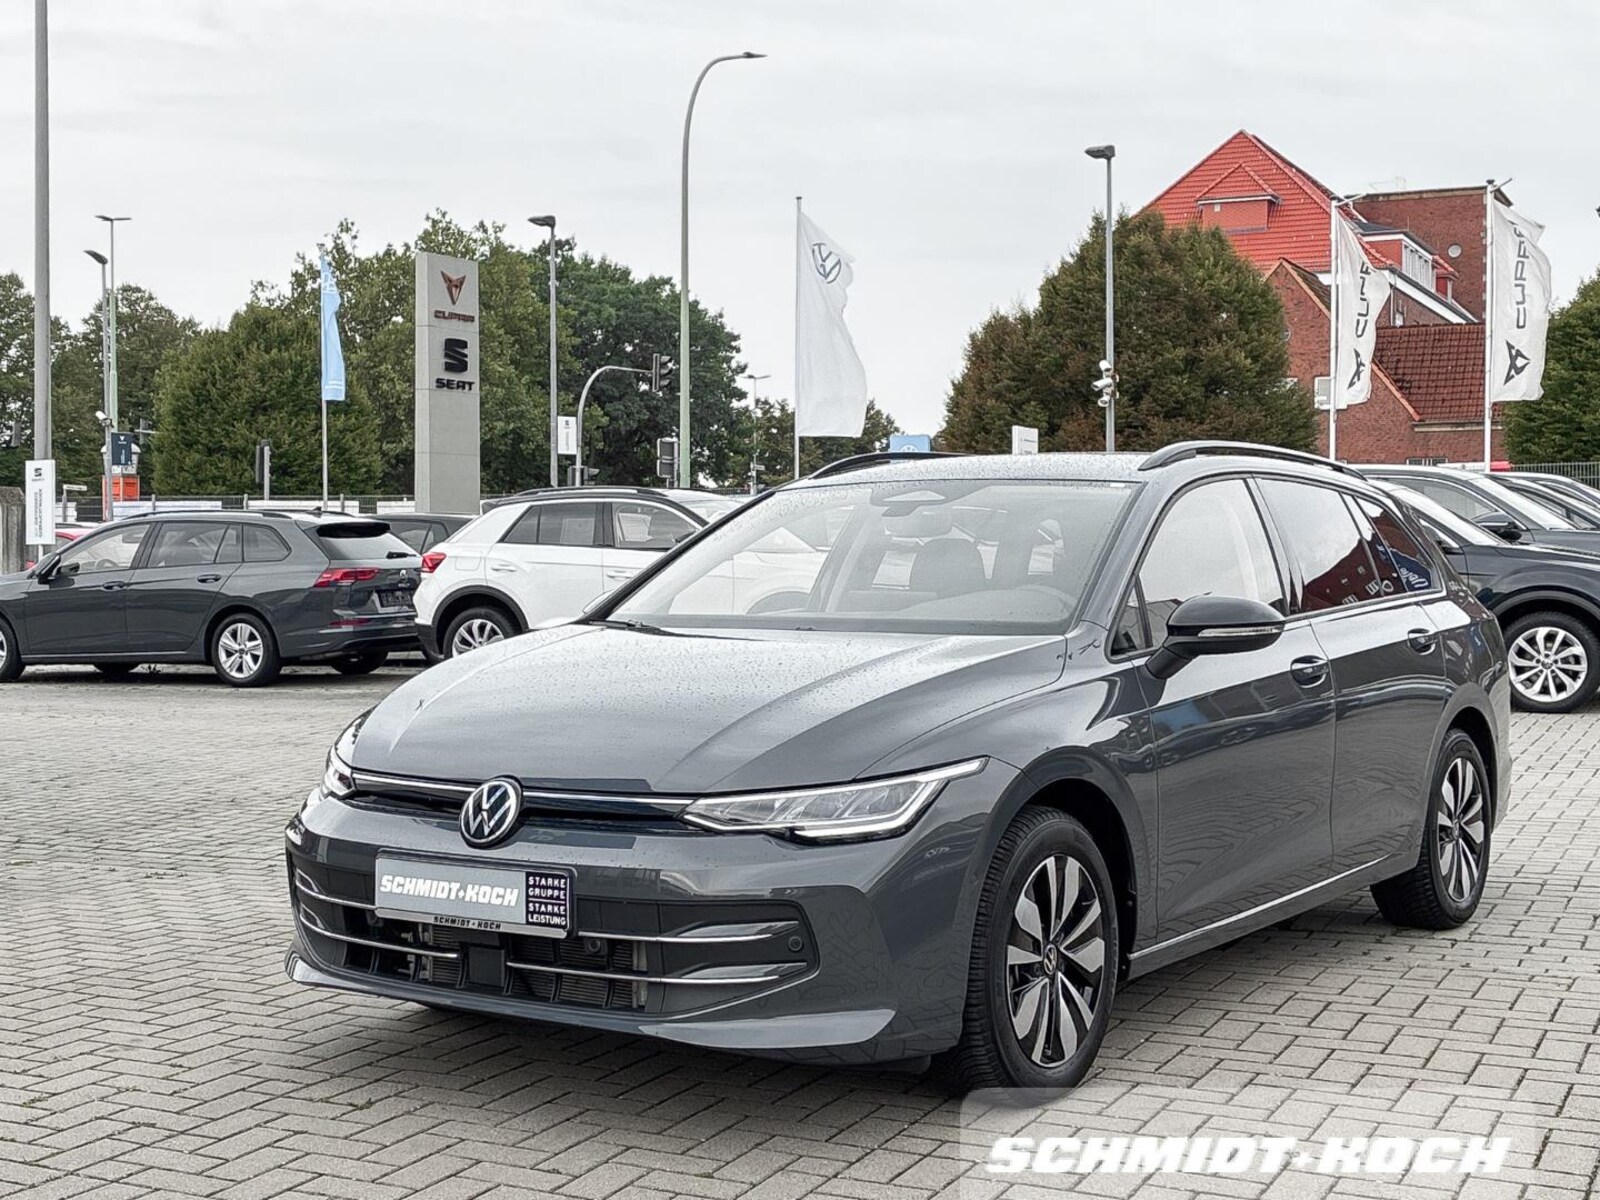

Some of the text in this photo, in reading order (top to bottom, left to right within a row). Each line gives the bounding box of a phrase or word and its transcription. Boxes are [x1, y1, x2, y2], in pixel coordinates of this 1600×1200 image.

[435, 377, 475, 391] SEAT
[528, 876, 566, 888] STARKE
[528, 888, 566, 899] GRUPPE
[528, 903, 566, 915] STARKE
[528, 914, 566, 925] LEISTUNG
